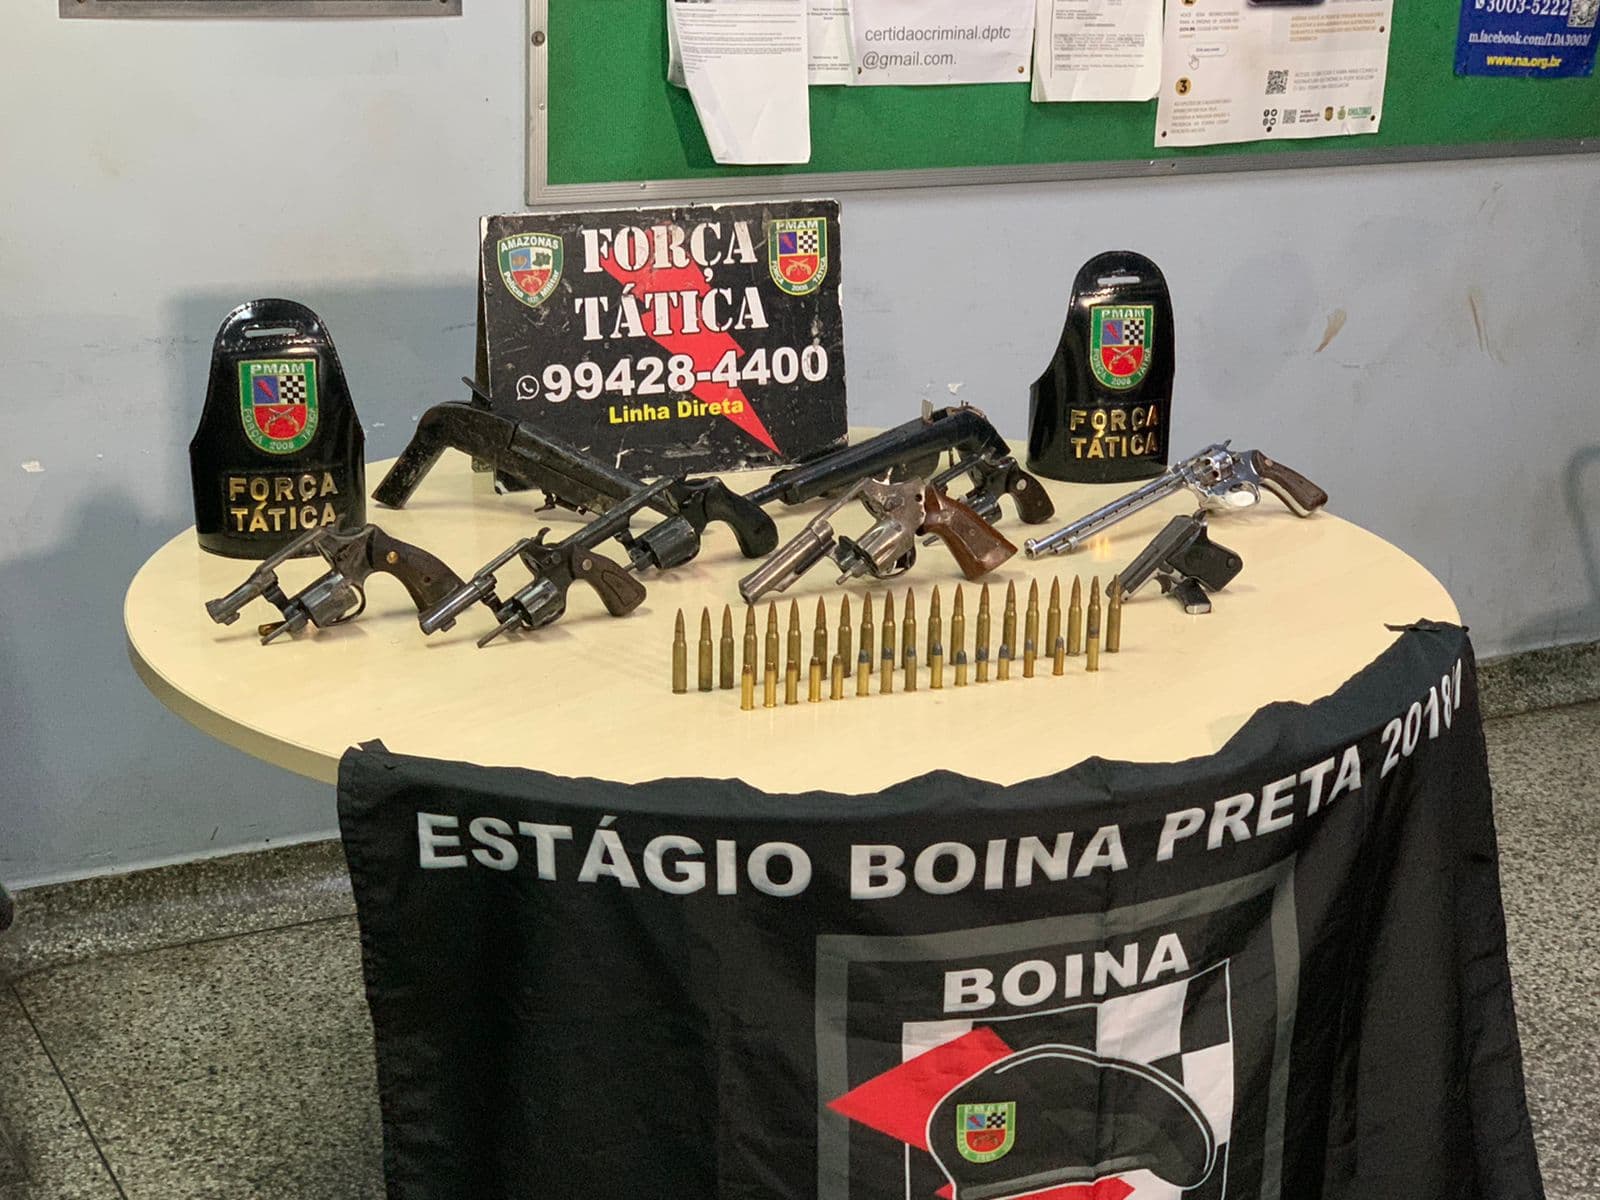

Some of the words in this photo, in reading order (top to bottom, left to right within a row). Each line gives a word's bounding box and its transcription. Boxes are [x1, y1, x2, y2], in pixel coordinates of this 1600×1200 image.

[1487, 0, 1569, 16] 3003-5222
[865, 25, 1011, 42] certidaocriminal.dptc
[862, 51, 957, 70] @gmail.com.
[1486, 55, 1562, 70] www.na.org.br
[1179, 79, 1188, 94] 3
[776, 220, 818, 230] PMAM
[501, 236, 559, 252] AMAZONAS
[581, 220, 758, 282] FORÇA
[540, 269, 560, 297] Militar
[575, 283, 769, 341] TÁTICA
[1101, 308, 1145, 319] PMAM
[250, 363, 305, 375] PMAM
[542, 345, 828, 404] 99428-4400
[608, 403, 670, 425] Linha
[677, 400, 744, 419] Direta
[1069, 404, 1158, 432] FORÇA
[1070, 431, 1157, 459] TÁTICA
[228, 471, 339, 502] FORÇA
[230, 501, 337, 532] TÁTICA
[417, 812, 812, 897] ESTÁGIO
[850, 824, 1128, 900] BOINA
[1155, 744, 1363, 862] PRETA
[943, 932, 1191, 1013] BOINA
